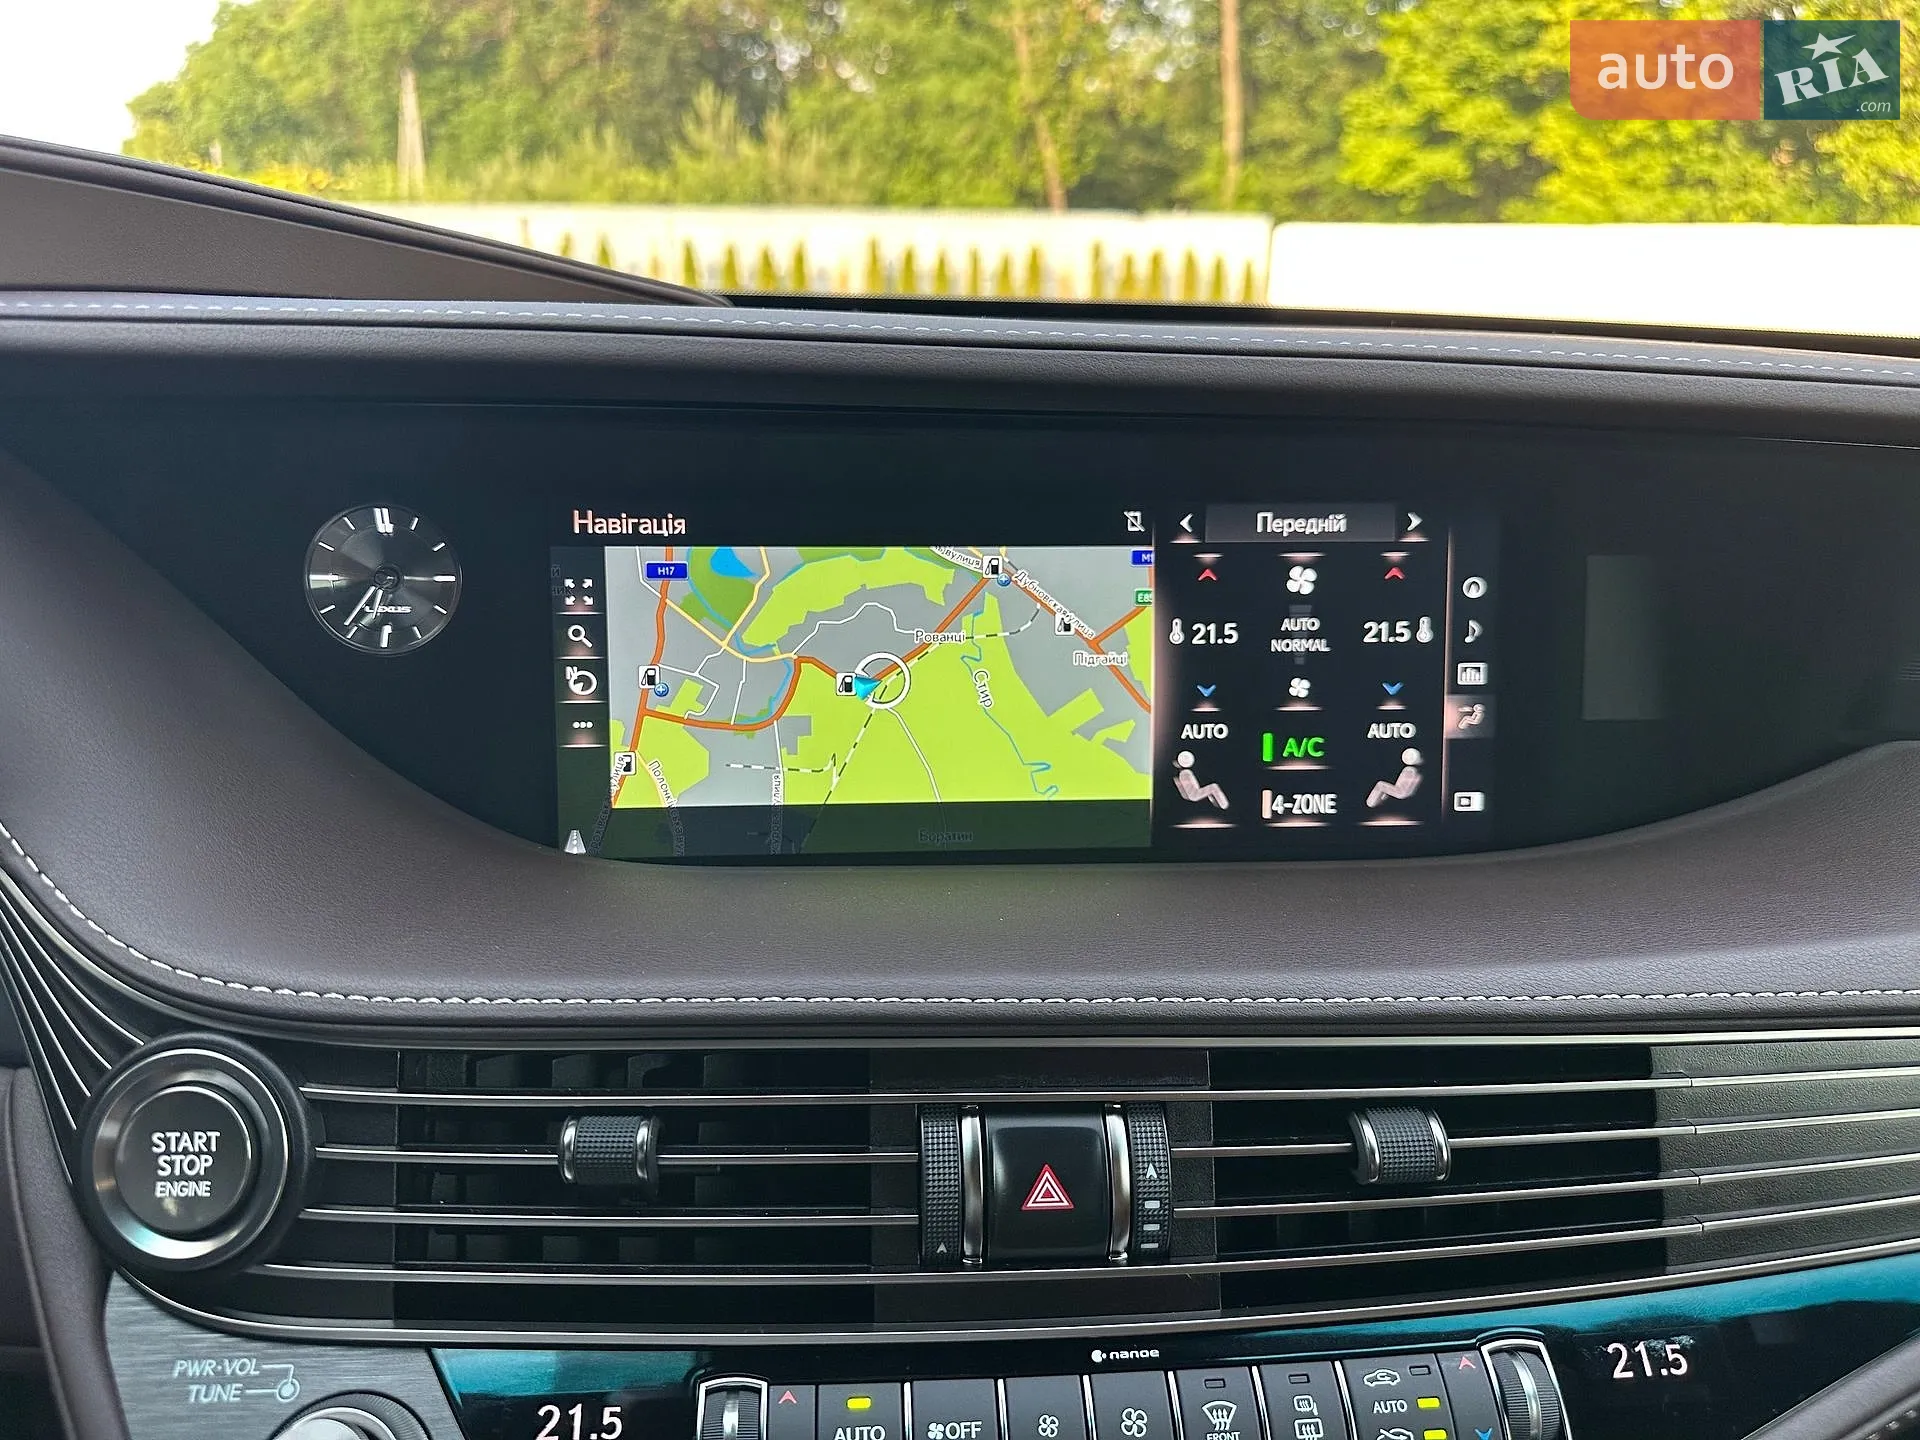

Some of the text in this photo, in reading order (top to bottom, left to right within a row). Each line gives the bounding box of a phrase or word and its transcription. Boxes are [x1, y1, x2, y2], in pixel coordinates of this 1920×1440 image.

[572, 510, 686, 537] Навігація
[1256, 511, 1347, 537] Передній
[1014, 570, 1068, 617] Дубновская
[1191, 622, 1239, 645] 21.5
[1280, 617, 1321, 631] AUTO
[1363, 621, 1412, 643] 21.5
[915, 631, 966, 643] Рованці
[1270, 638, 1331, 652] NORMAL
[1075, 653, 1127, 665] Підгайці
[974, 671, 993, 708] Стир
[1180, 723, 1229, 740] AUTO
[1367, 722, 1416, 739] AUTO
[1282, 737, 1326, 758] A/C
[1271, 793, 1338, 814] 4-ZONE
[151, 1131, 221, 1153] START
[157, 1154, 213, 1176] STOP
[154, 1181, 212, 1198] ENGINE
[1109, 1349, 1160, 1360] nanoe
[1607, 1341, 1688, 1379] 21.5
[188, 1384, 243, 1402] TUNE
[1373, 1400, 1408, 1414] AUTO
[535, 1403, 623, 1440] 21.5
[945, 1421, 982, 1440] OFF
[834, 1426, 886, 1440] AUTO
[1206, 1431, 1241, 1440] FRONT
